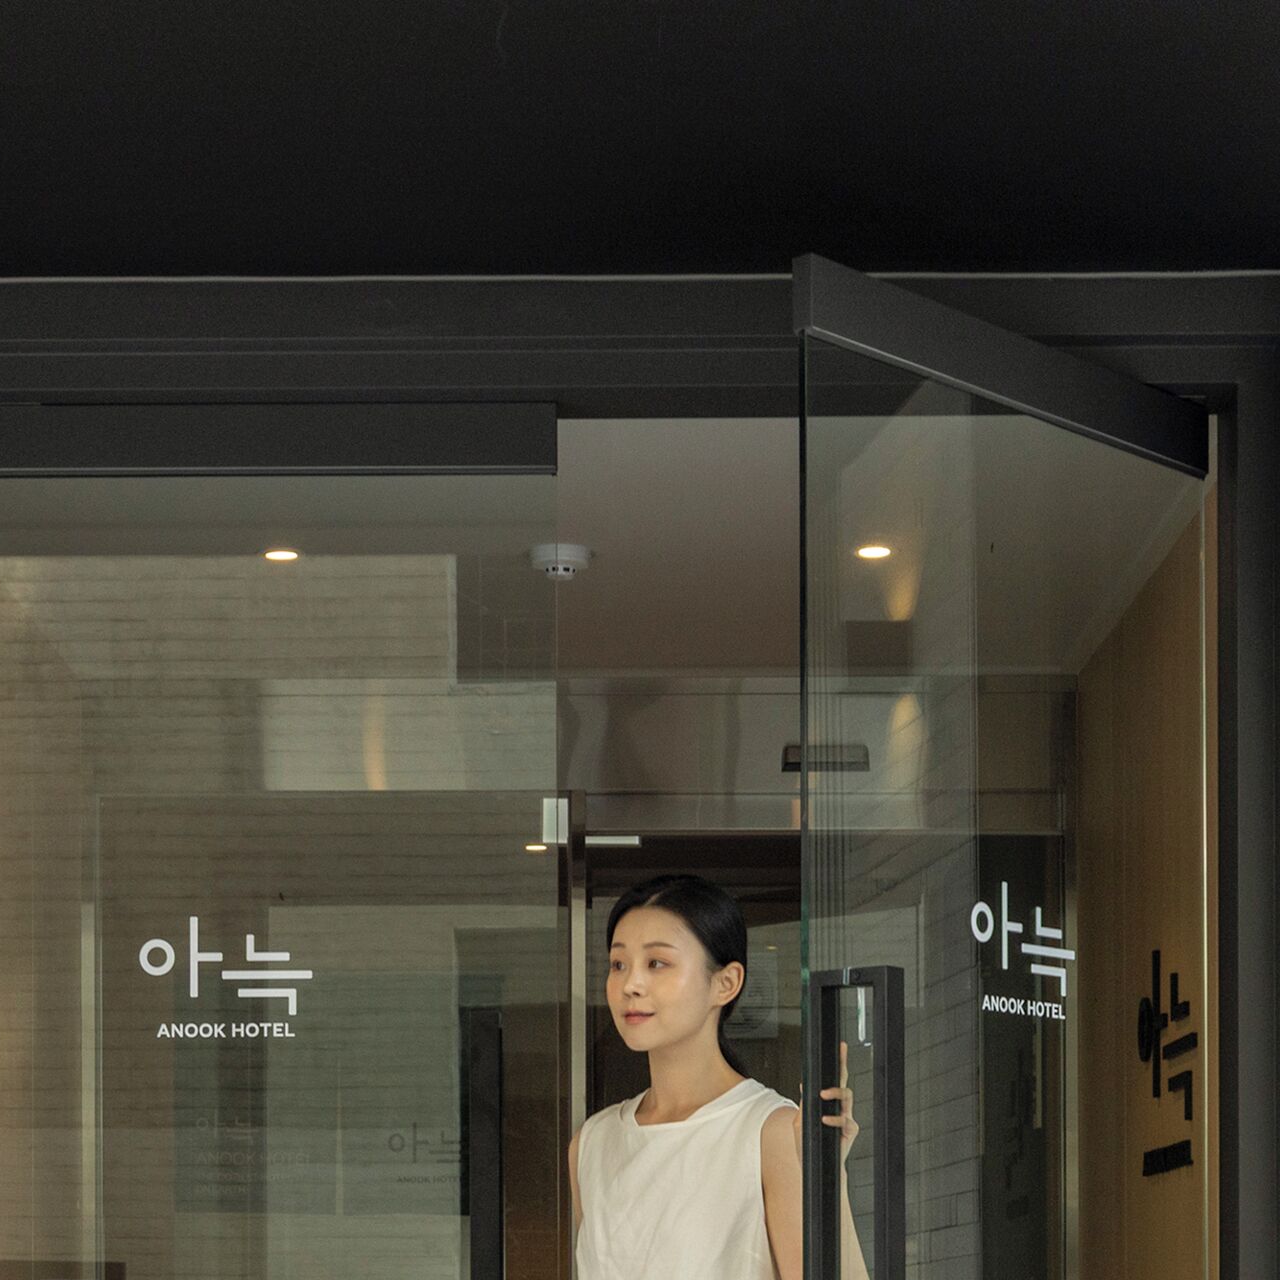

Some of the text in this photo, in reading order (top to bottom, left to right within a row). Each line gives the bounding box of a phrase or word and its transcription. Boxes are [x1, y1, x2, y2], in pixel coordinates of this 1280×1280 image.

[139, 916, 313, 1016] 아늑
[970, 881, 1076, 998] 아늑
[156, 1022, 296, 1038] ANOOK HOTEL
[981, 994, 1067, 1020] ANOOK HOTEL
